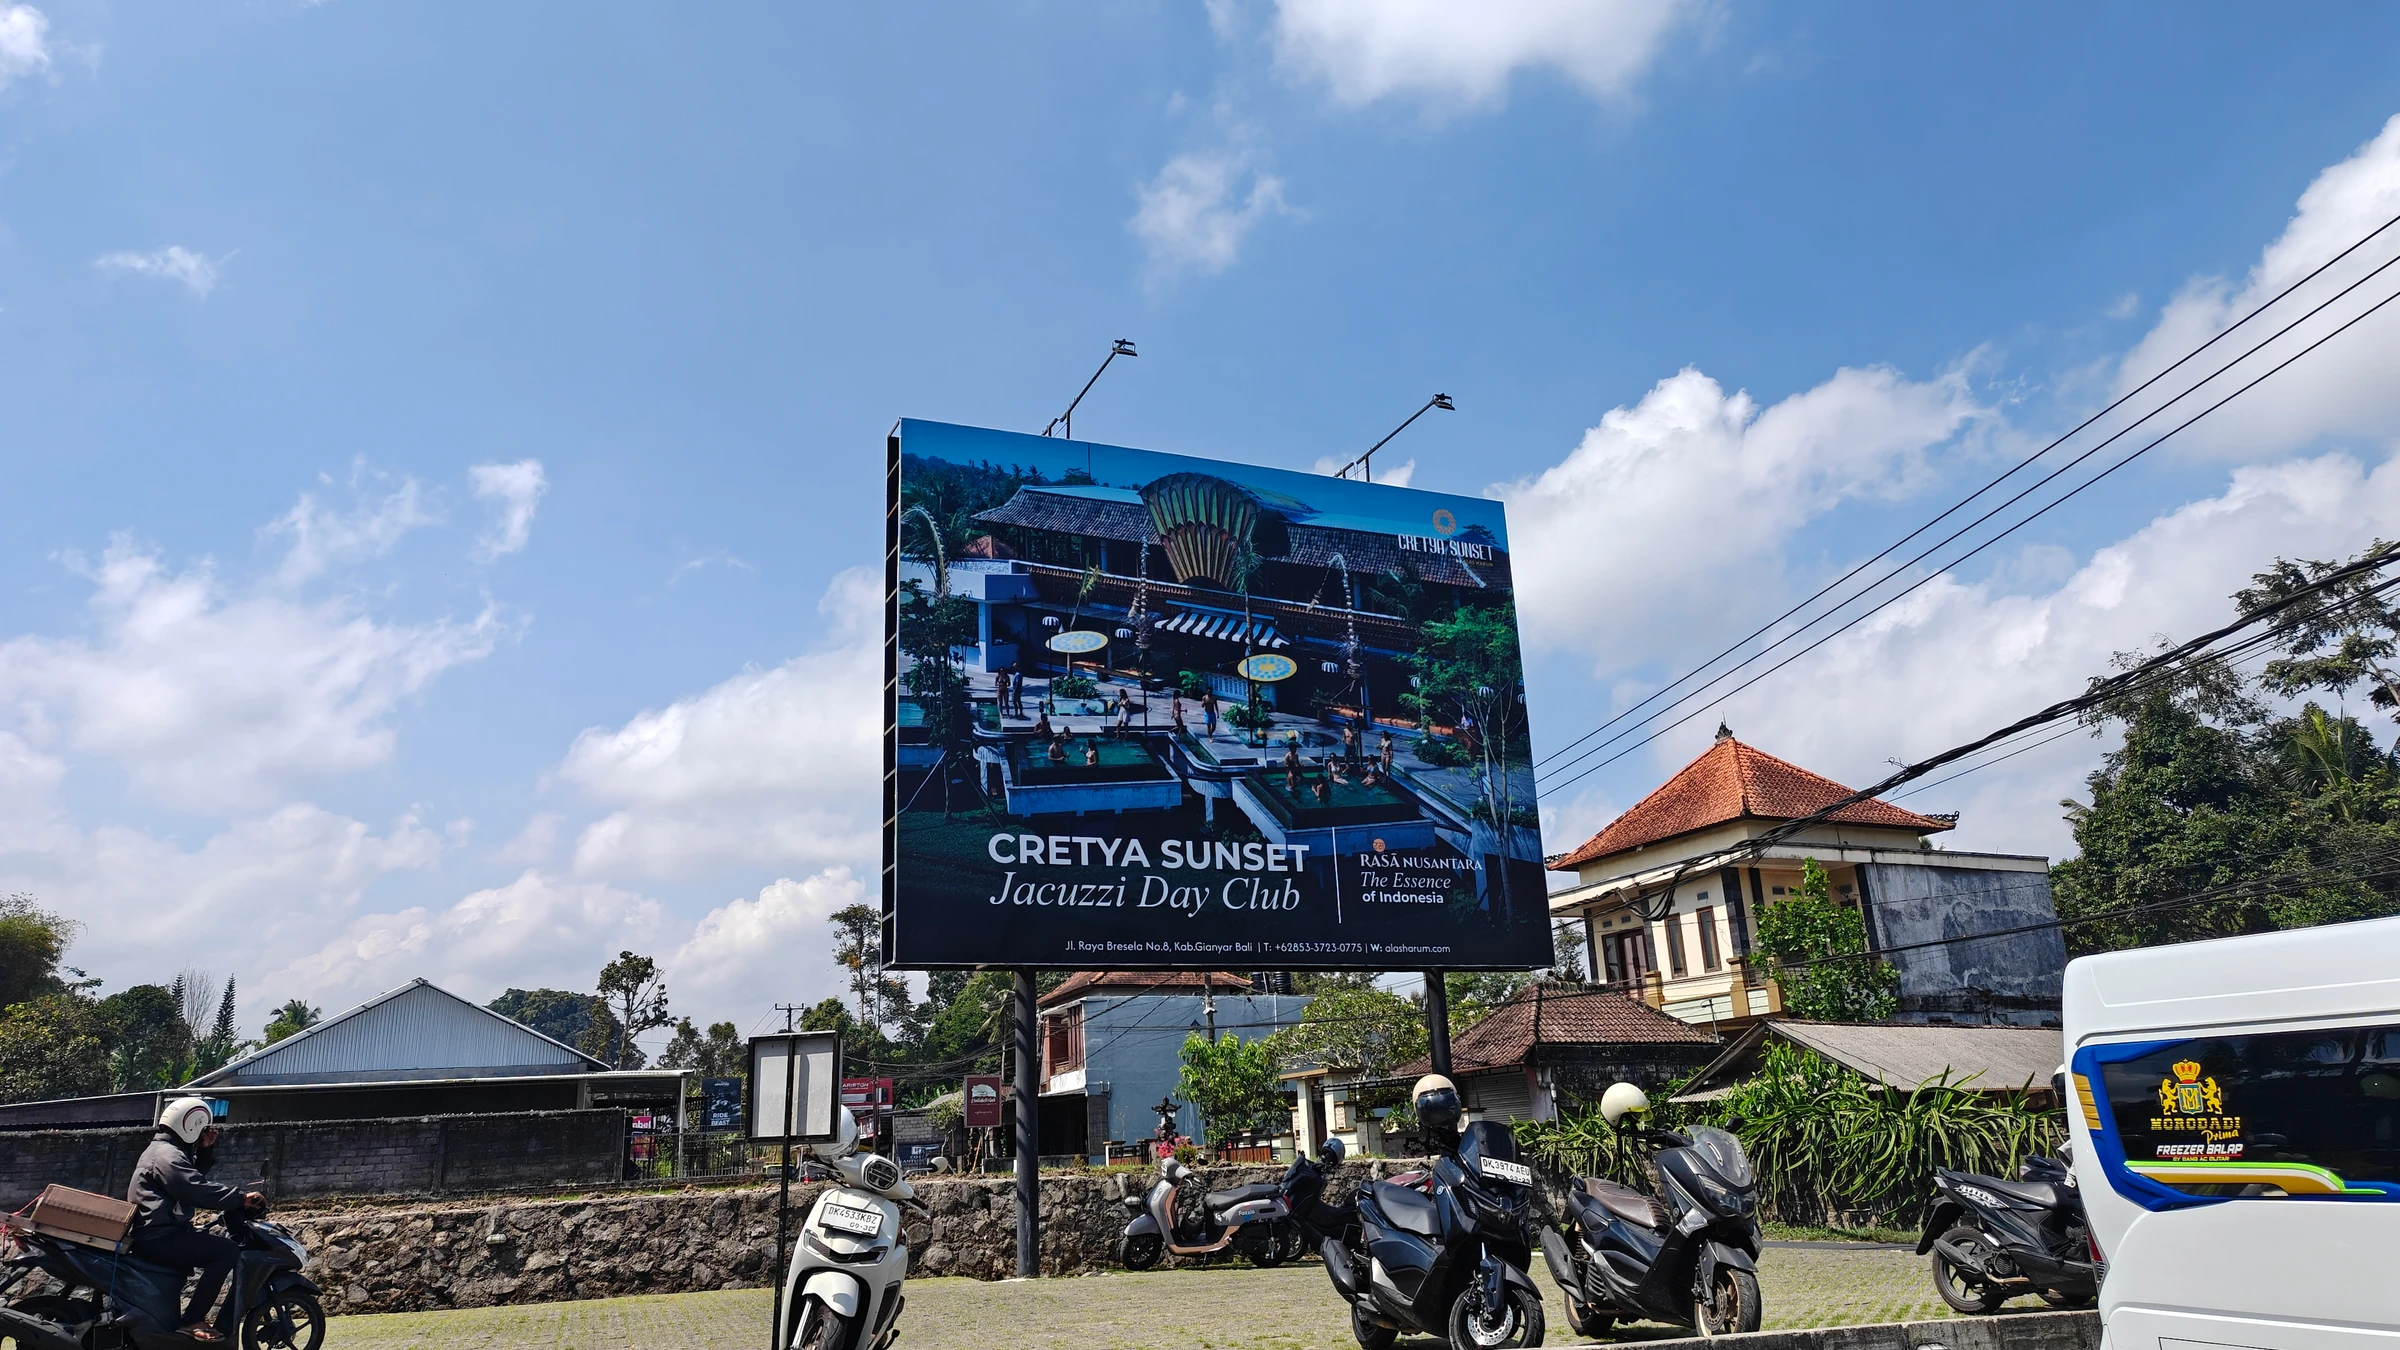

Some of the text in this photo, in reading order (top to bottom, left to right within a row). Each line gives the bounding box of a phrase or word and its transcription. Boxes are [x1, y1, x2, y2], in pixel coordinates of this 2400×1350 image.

[1398, 534, 1493, 561] CRETYA SUNSET
[988, 833, 1310, 872] CRETYA SUNSET
[1402, 856, 1483, 871] NUSANTARA
[1360, 871, 1452, 889] The Essence
[989, 871, 1301, 918] Jacuzzi Day Club
[1362, 890, 1445, 904] of Indonesia
[1065, 940, 1253, 954] Jl. Raya Bresela No.8, Kab.Gianyar Bali
[1263, 942, 1363, 953] T: +62853-3723-0775
[1370, 943, 1451, 953] W: alasharum.com
[2150, 1117, 2241, 1131] MORODADI
[2201, 1129, 2240, 1145] Prima
[2156, 1143, 2244, 1156] FREEZER BALAP
